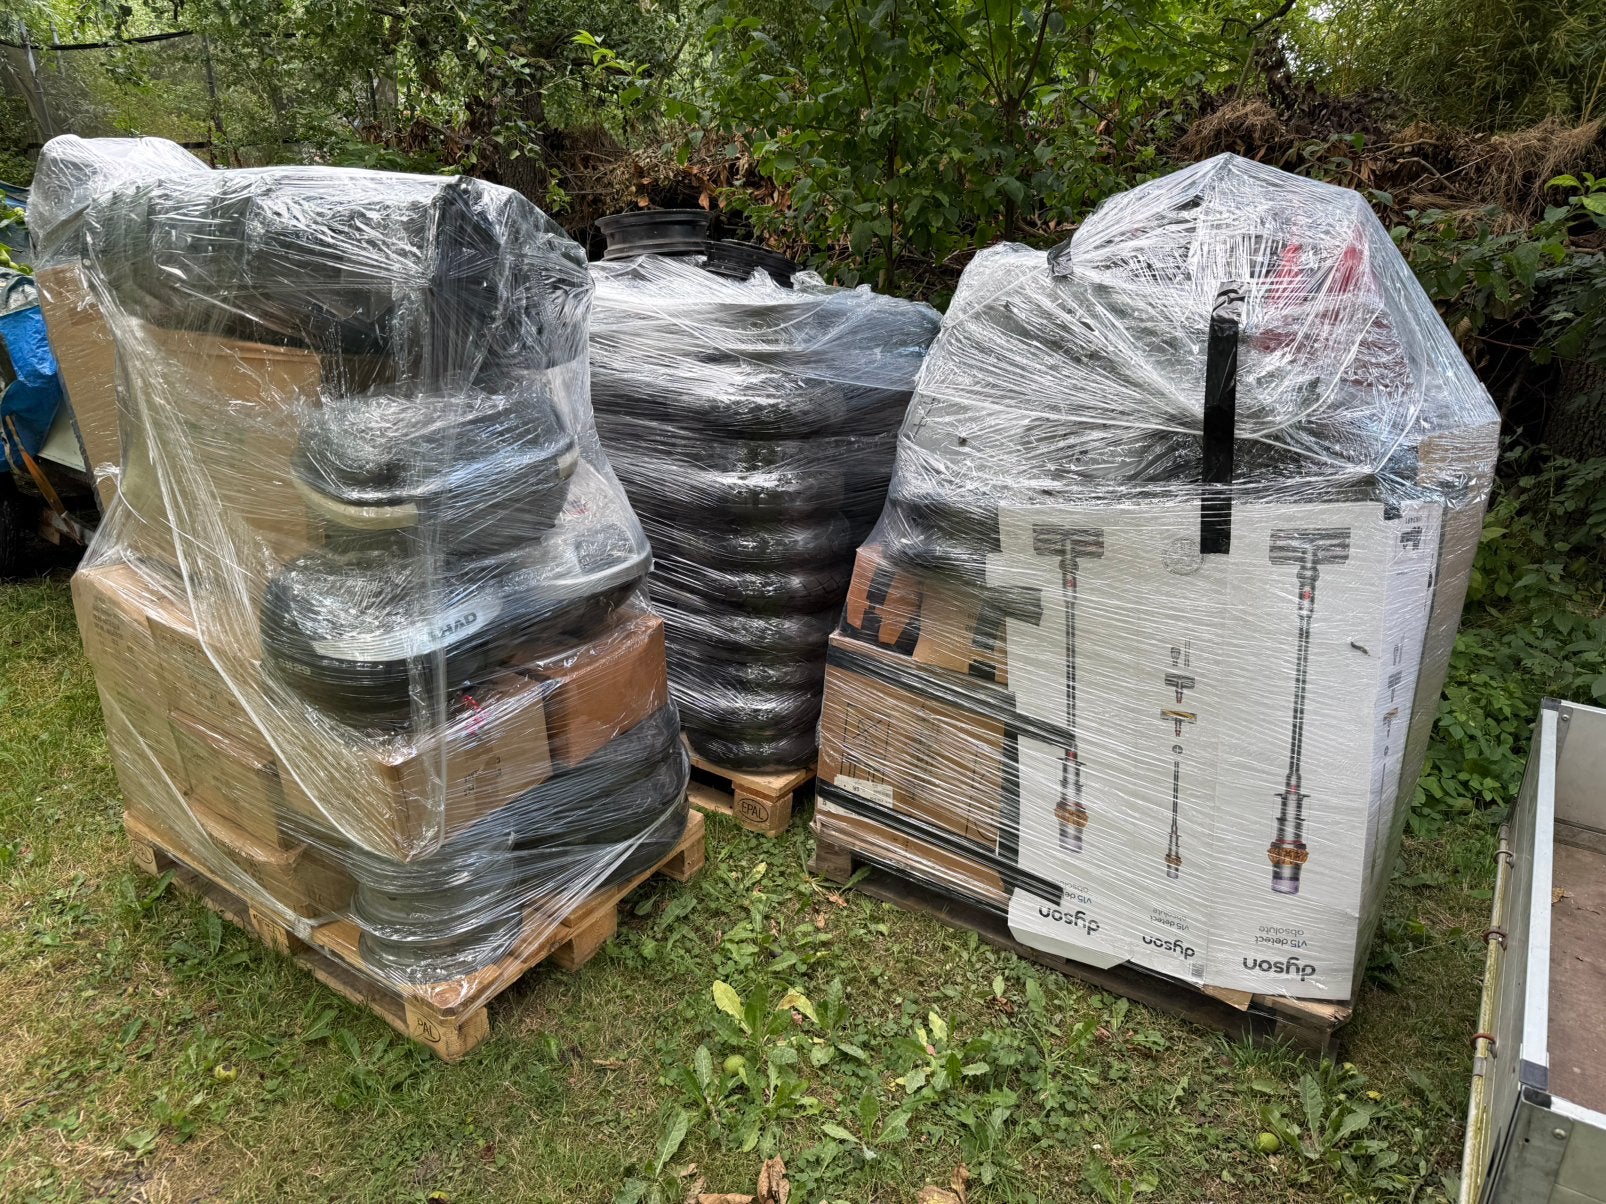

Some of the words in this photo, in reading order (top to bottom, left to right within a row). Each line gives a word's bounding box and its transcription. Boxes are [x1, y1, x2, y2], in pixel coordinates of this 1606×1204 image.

[741, 801, 764, 820] EPAL
[1077, 895, 1092, 904] v15
[1038, 905, 1101, 936] dyson
[1258, 925, 1305, 938] absolute
[1142, 935, 1196, 960] dyson
[1254, 935, 1288, 948] detect
[1290, 939, 1308, 949] v15
[1242, 956, 1316, 981] dyson
[415, 1016, 437, 1040] PAL
